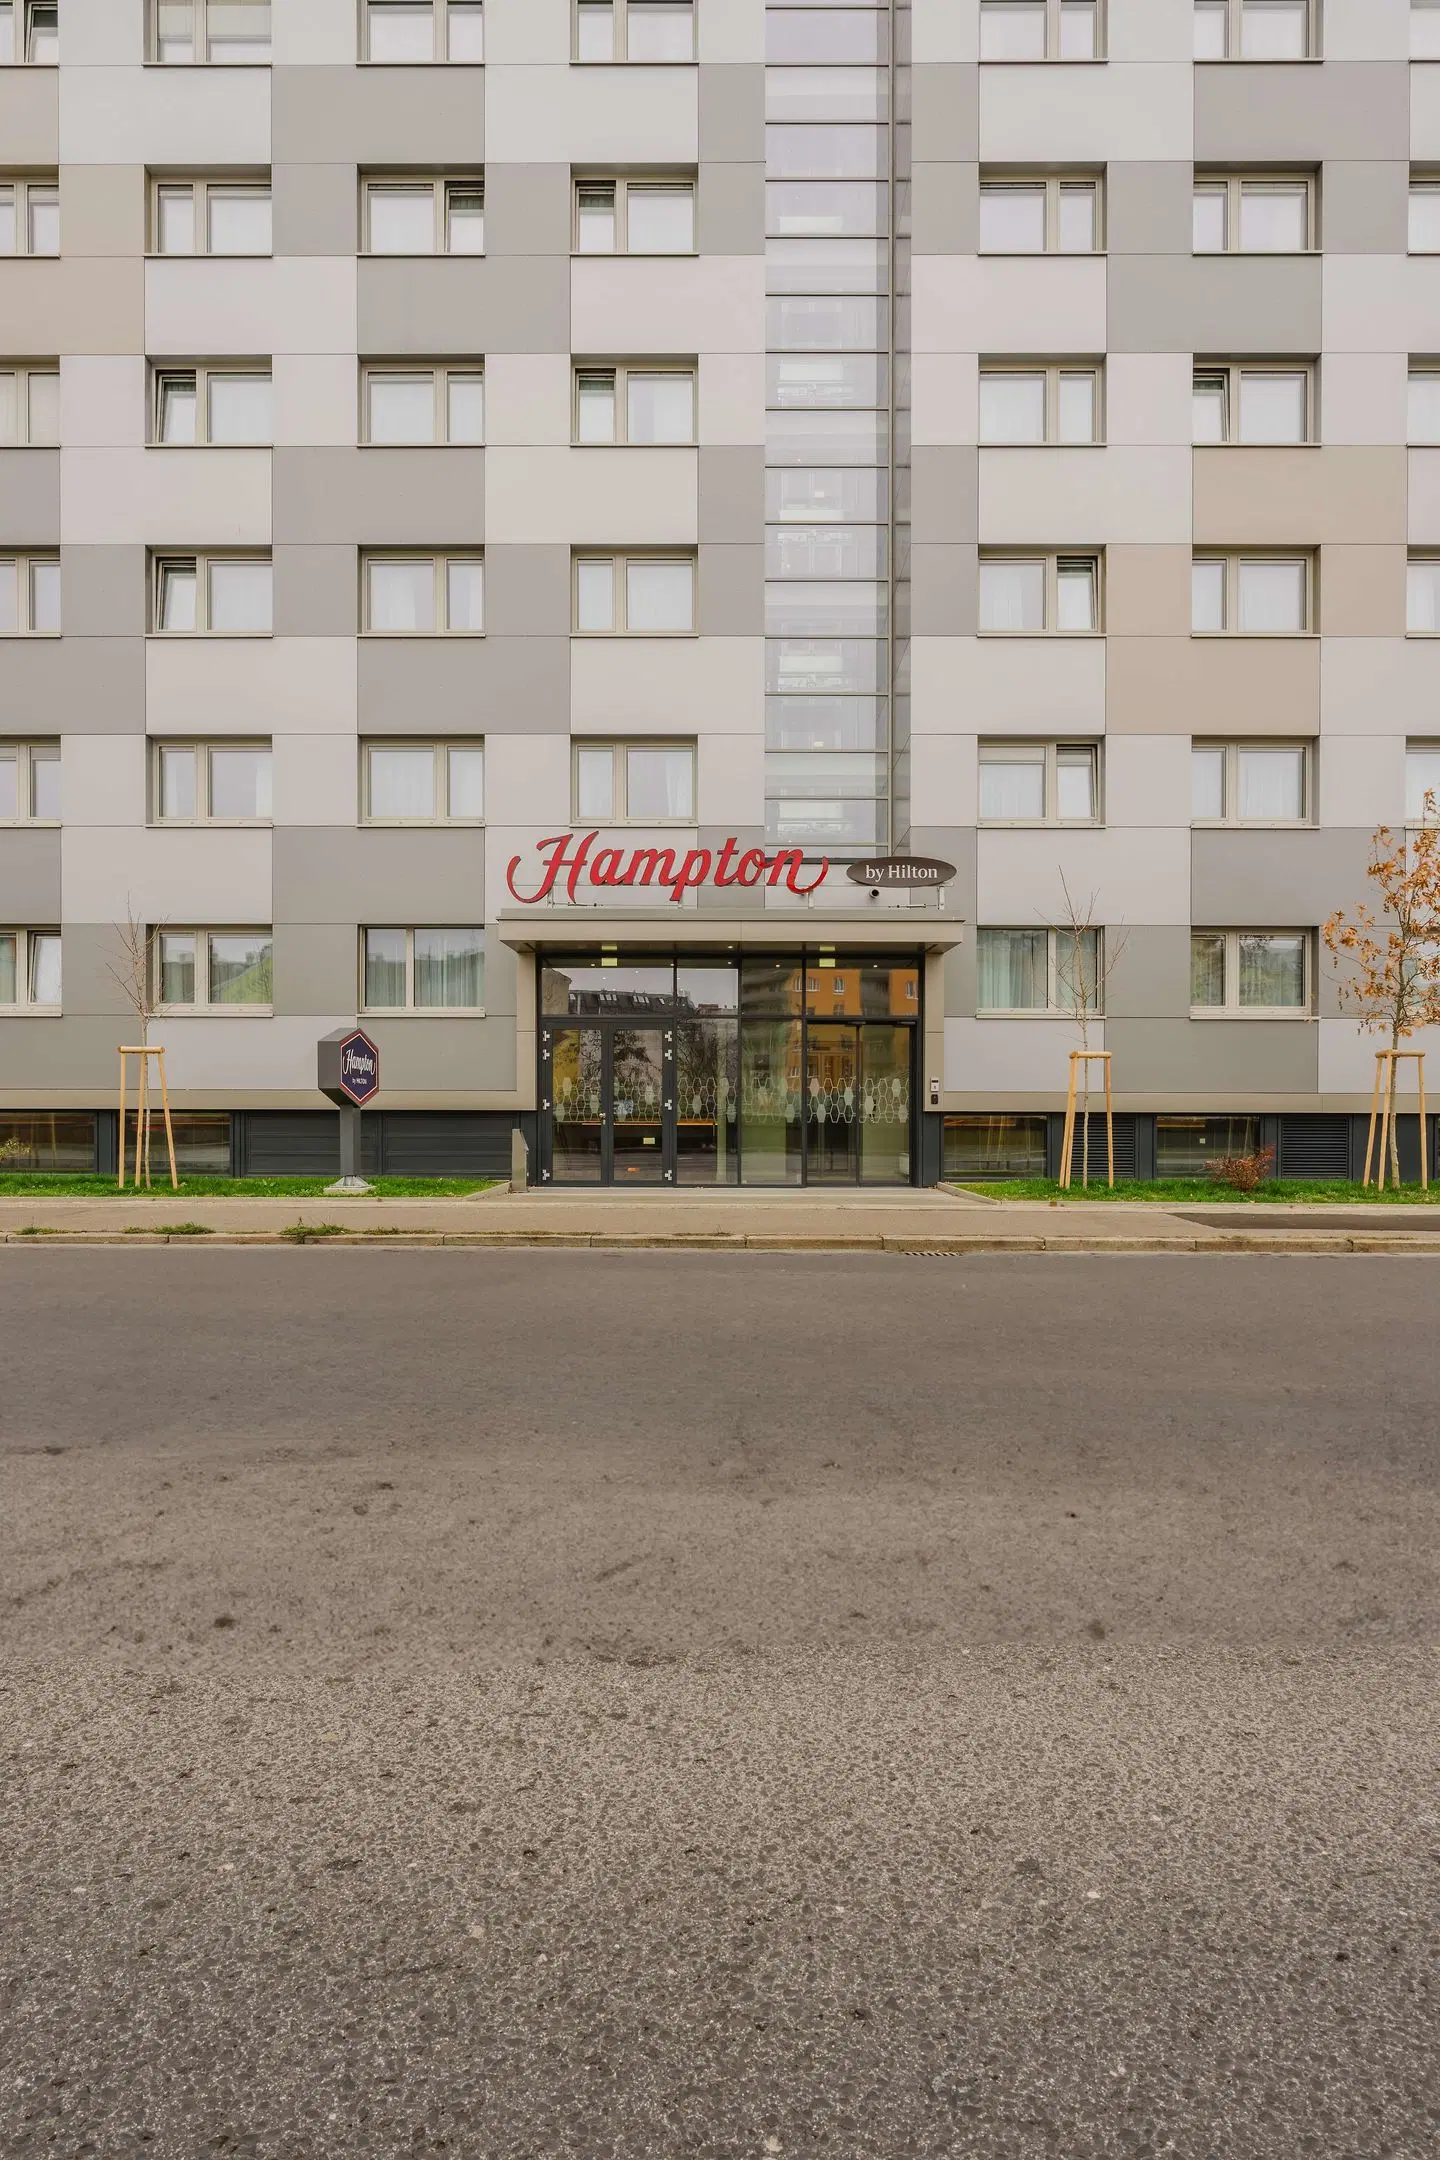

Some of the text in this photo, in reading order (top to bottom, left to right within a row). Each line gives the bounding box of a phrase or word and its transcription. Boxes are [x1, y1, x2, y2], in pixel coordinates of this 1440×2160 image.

[507, 831, 828, 904] Hampton
[865, 864, 938, 882] by Hilton
[342, 1049, 376, 1075] Hampton
